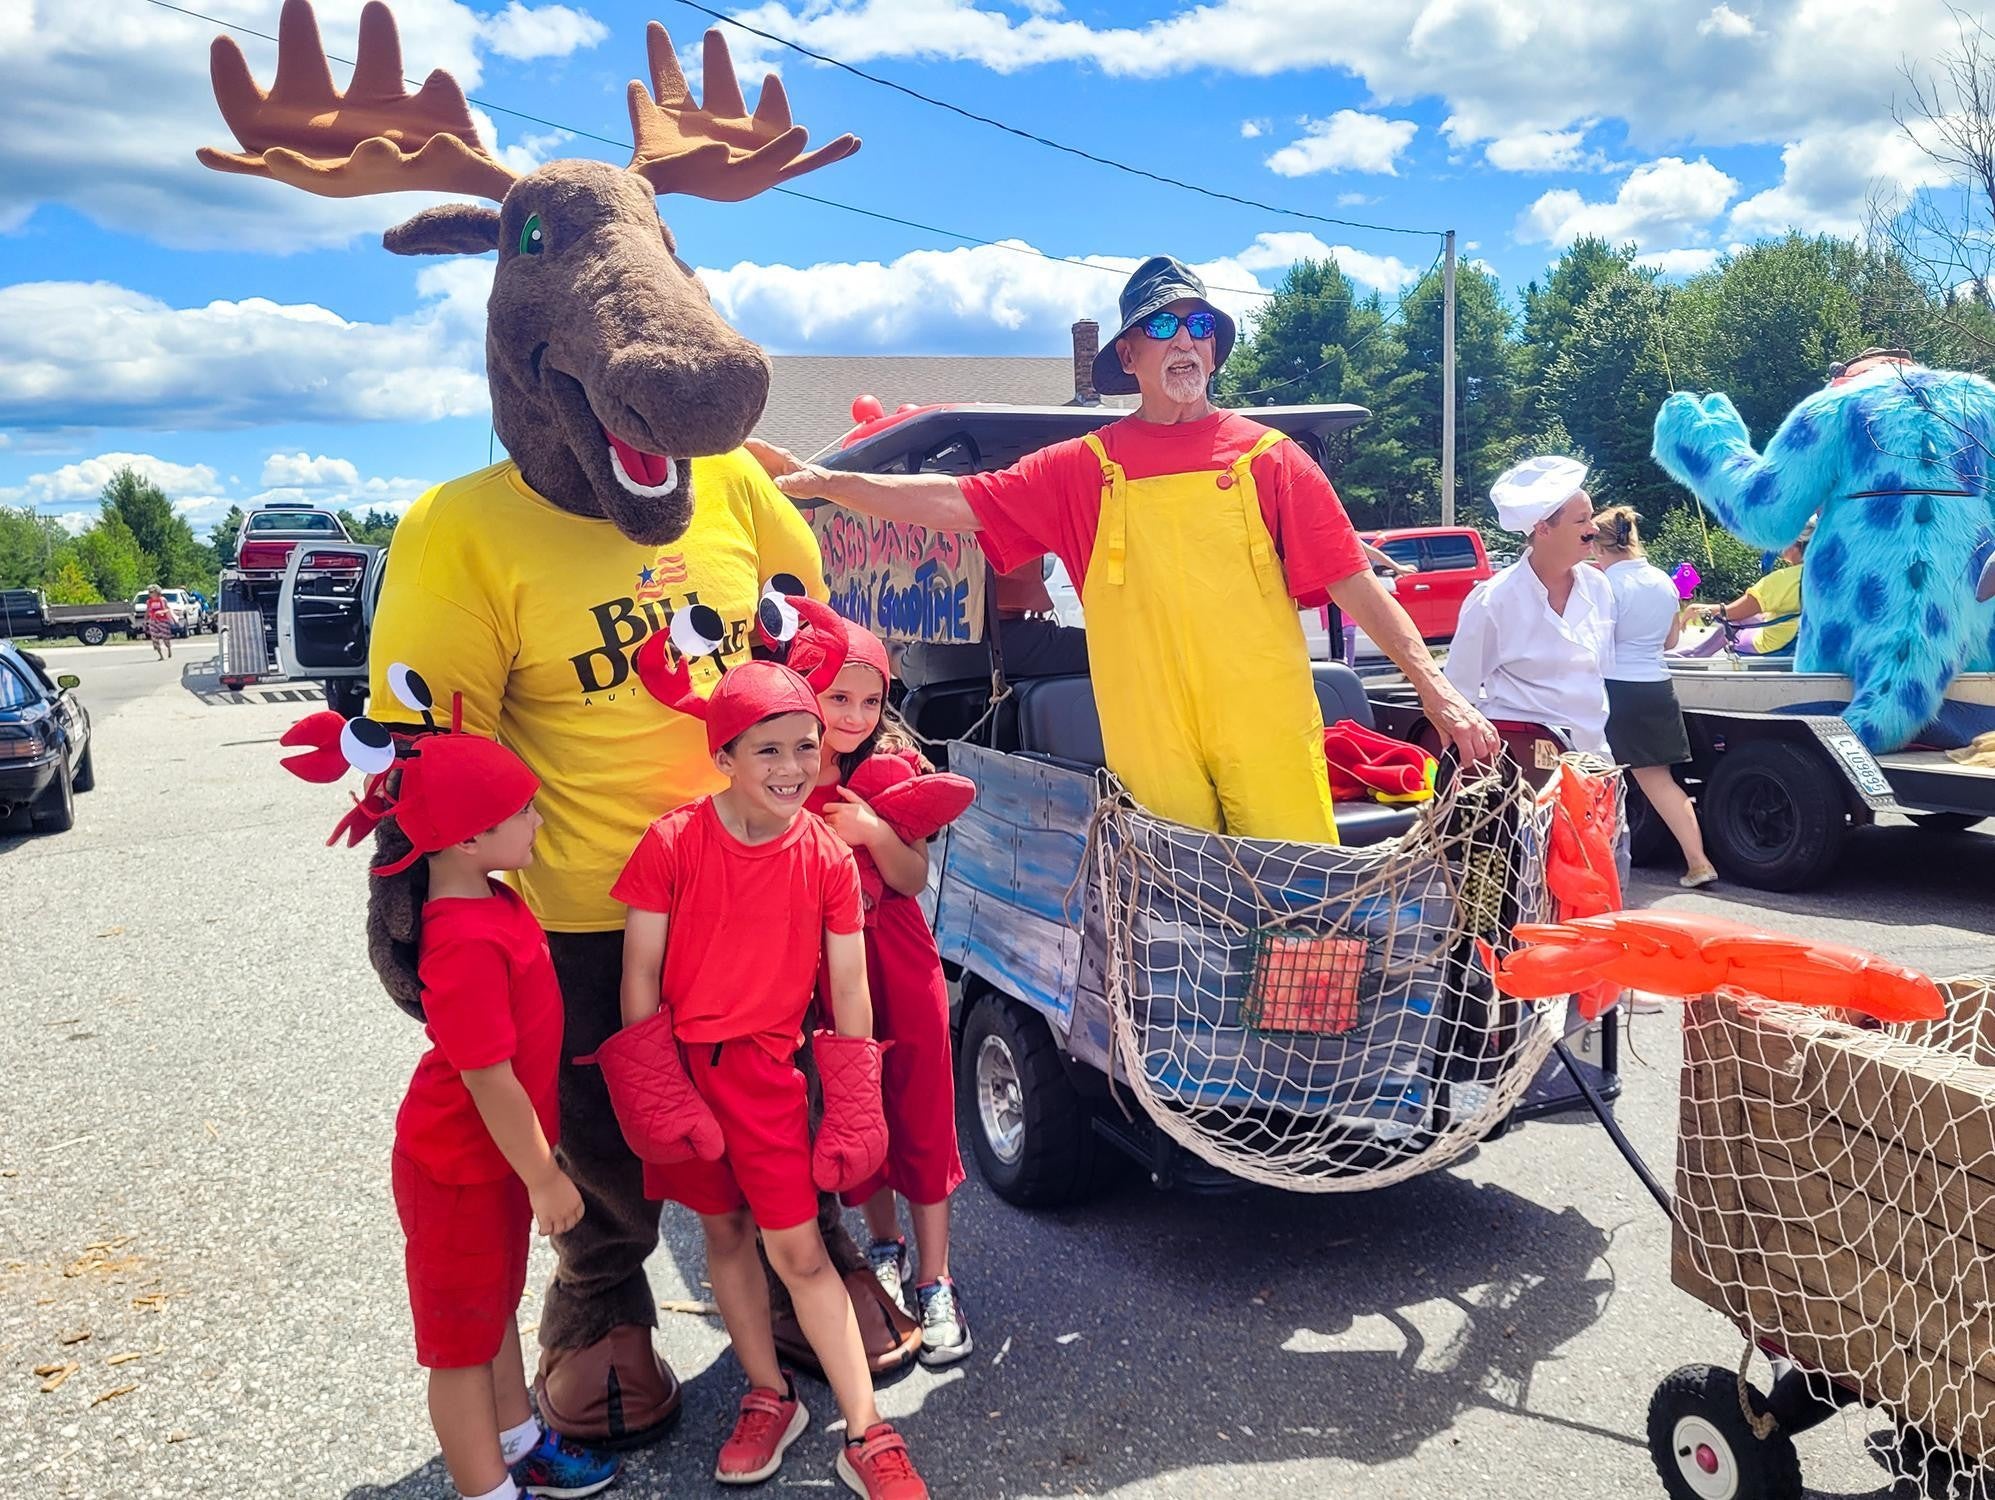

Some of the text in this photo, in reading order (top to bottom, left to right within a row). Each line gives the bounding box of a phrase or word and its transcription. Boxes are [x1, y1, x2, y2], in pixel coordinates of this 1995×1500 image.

[803, 508, 867, 577] ASCO
[588, 591, 699, 650] BI
[584, 687, 637, 707] AUT
